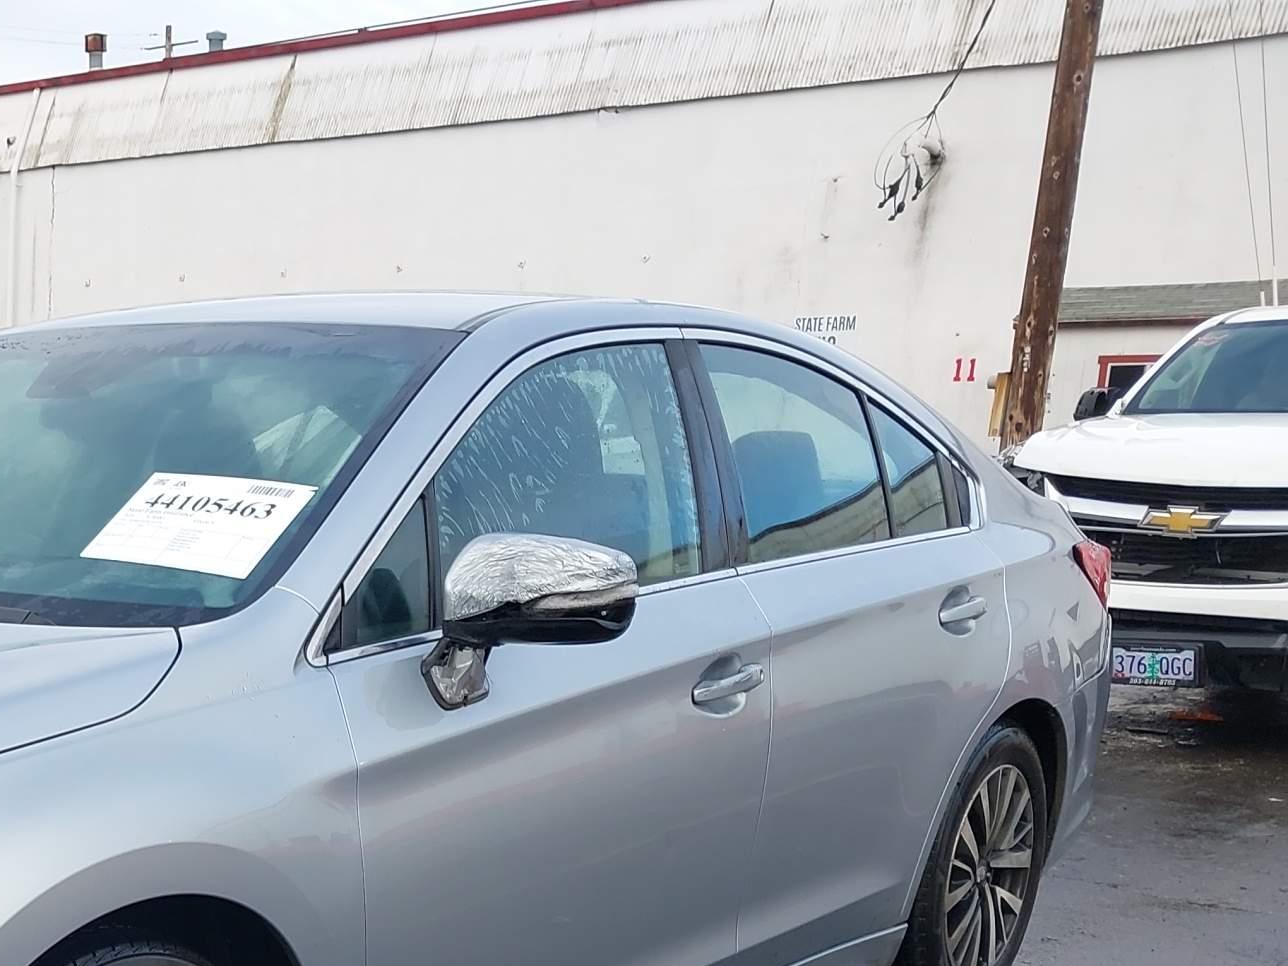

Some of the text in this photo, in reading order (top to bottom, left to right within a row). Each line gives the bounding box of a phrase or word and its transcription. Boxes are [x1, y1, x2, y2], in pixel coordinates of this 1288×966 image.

[795, 316, 857, 332] STATE FARM
[953, 358, 976, 382] 11
[145, 493, 276, 520] 44105463
[1115, 655, 1192, 677] 376 QGC
